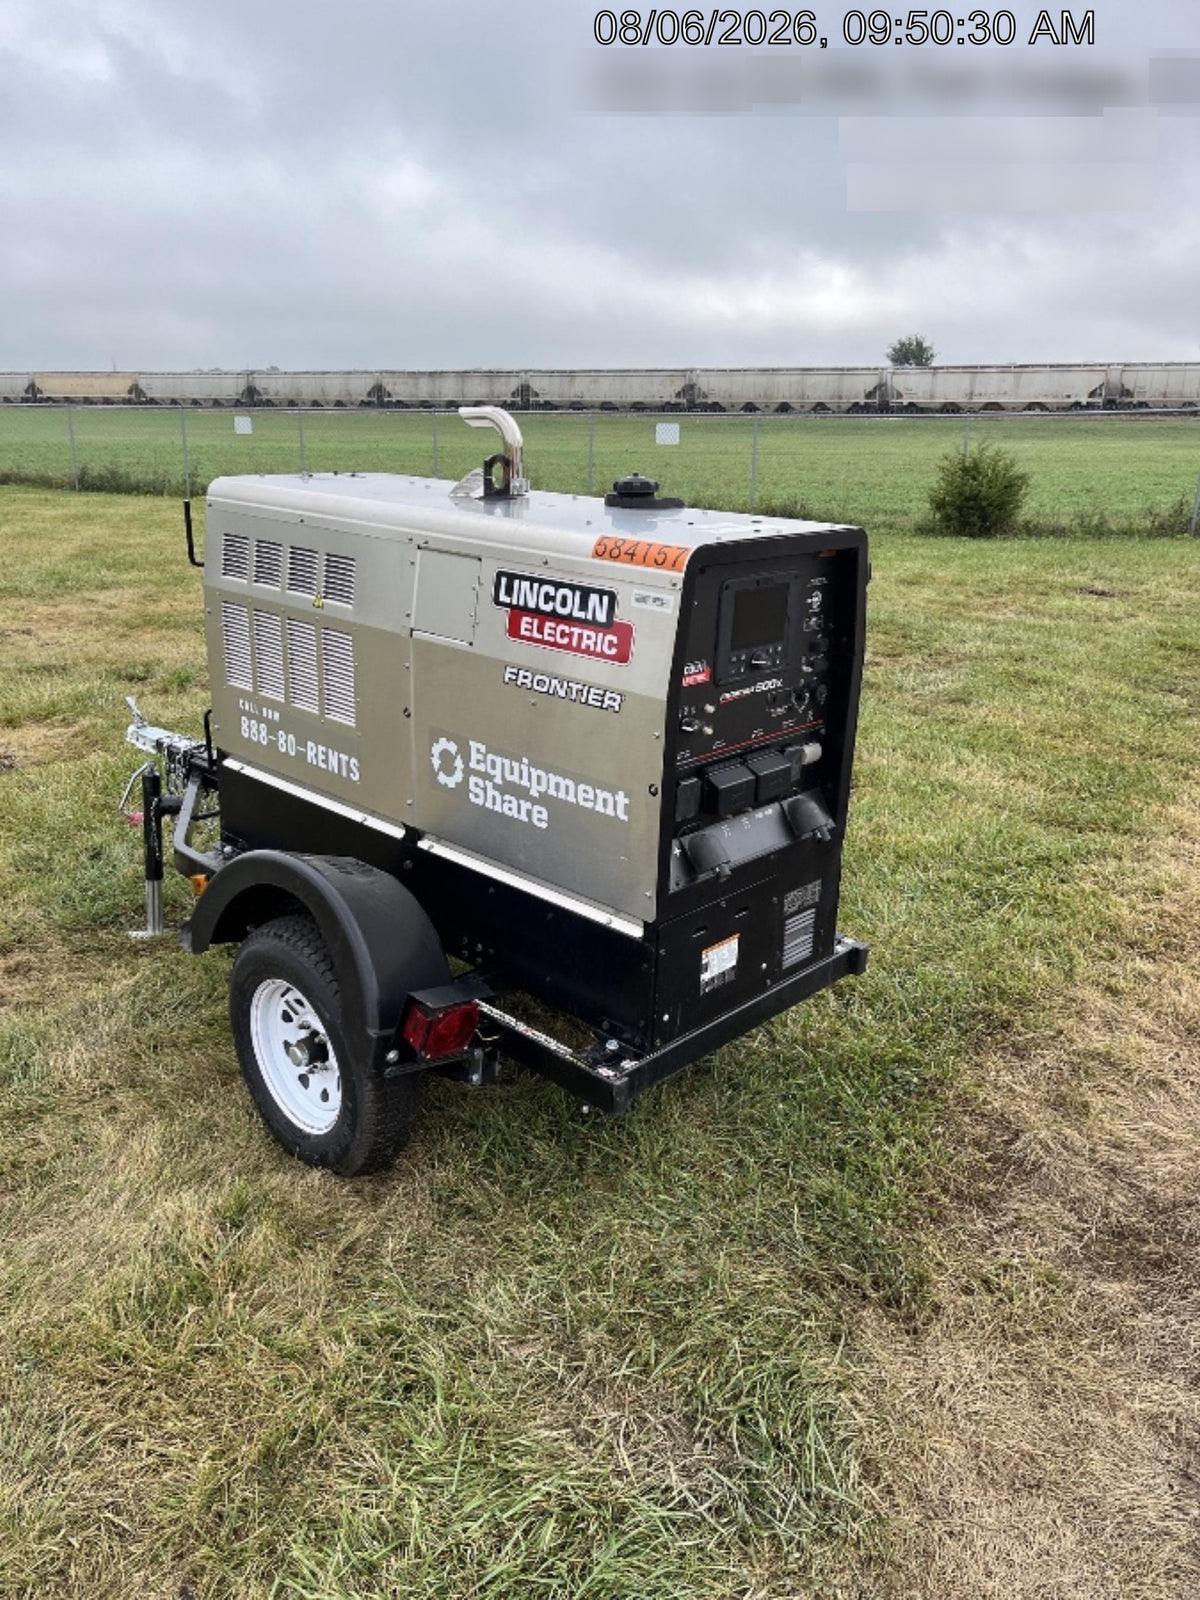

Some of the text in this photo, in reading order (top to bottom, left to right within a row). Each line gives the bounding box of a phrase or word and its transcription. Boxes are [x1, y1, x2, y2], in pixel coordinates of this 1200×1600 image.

[595, 536, 689, 568] 584157
[499, 576, 609, 623] LINCOLN
[520, 615, 618, 655] ELECTRIC
[503, 665, 622, 713] FRONTIER
[241, 715, 360, 782] 888-80-RENTS
[468, 739, 630, 822] Equipment
[468, 774, 549, 829] Share
